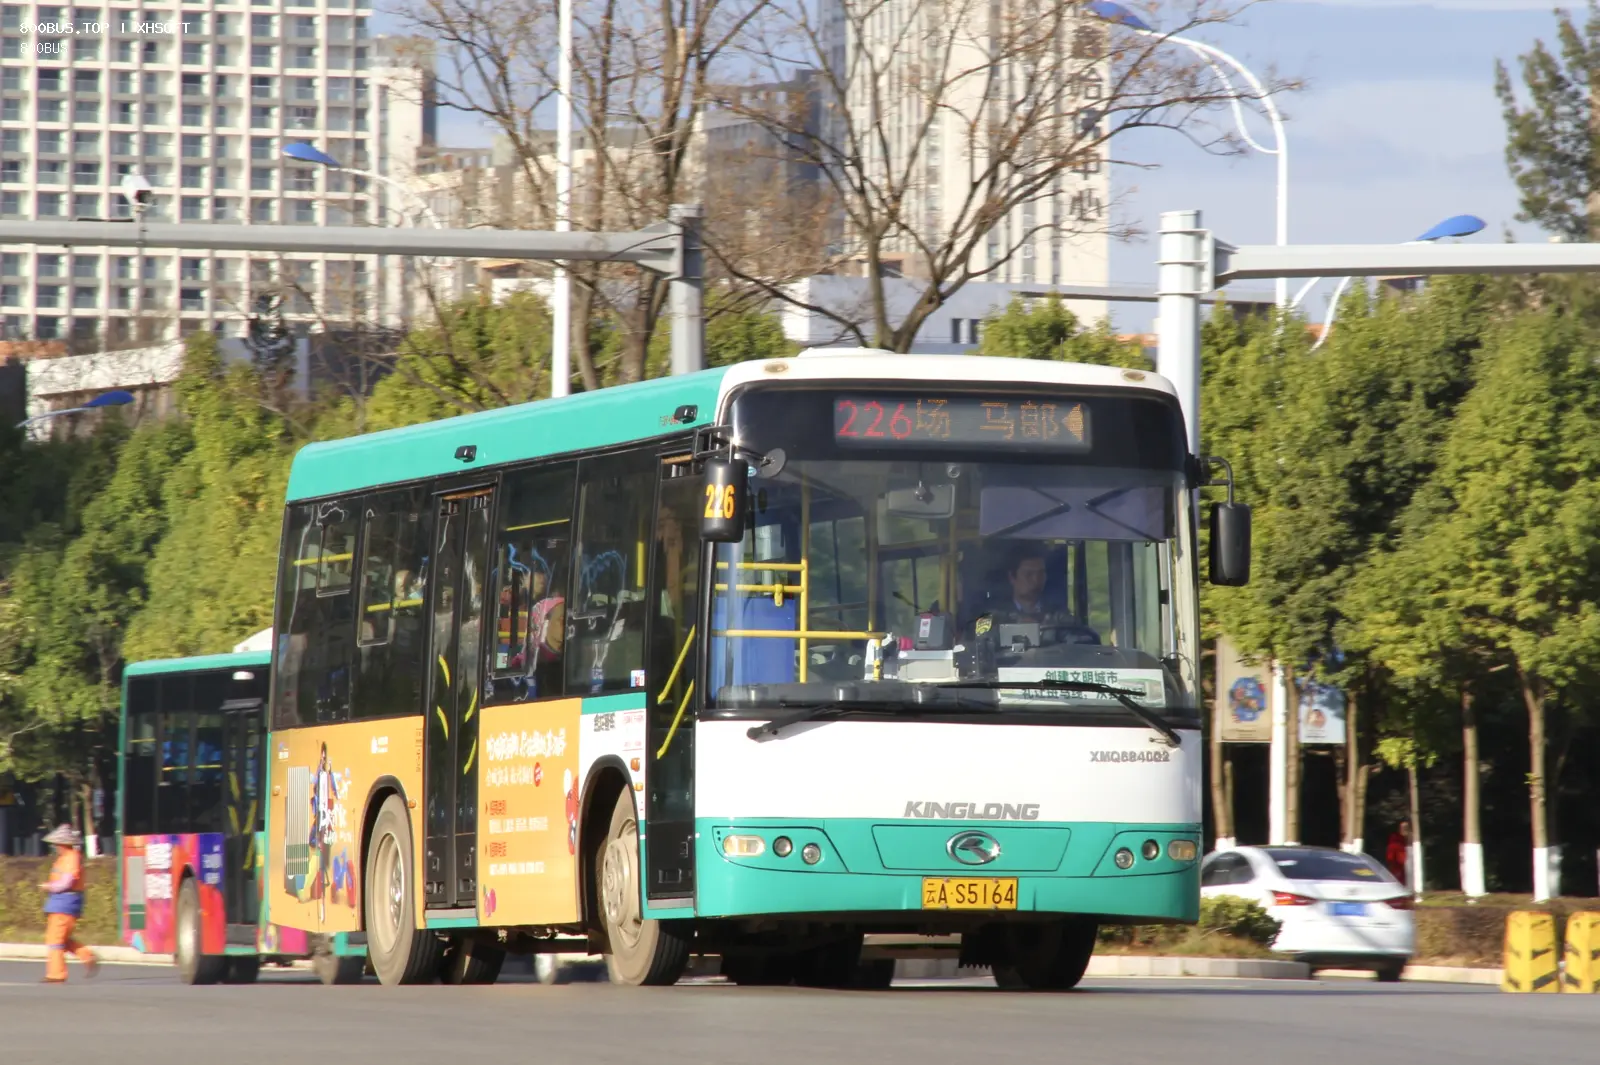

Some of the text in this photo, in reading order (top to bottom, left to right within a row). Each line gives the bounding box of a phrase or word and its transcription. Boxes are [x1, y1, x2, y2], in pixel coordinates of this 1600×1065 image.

[836, 400, 913, 440] 226
[704, 483, 735, 519] 226
[1045, 670, 1118, 685] 创建文明城市
[903, 800, 1041, 821] KINGLONG
